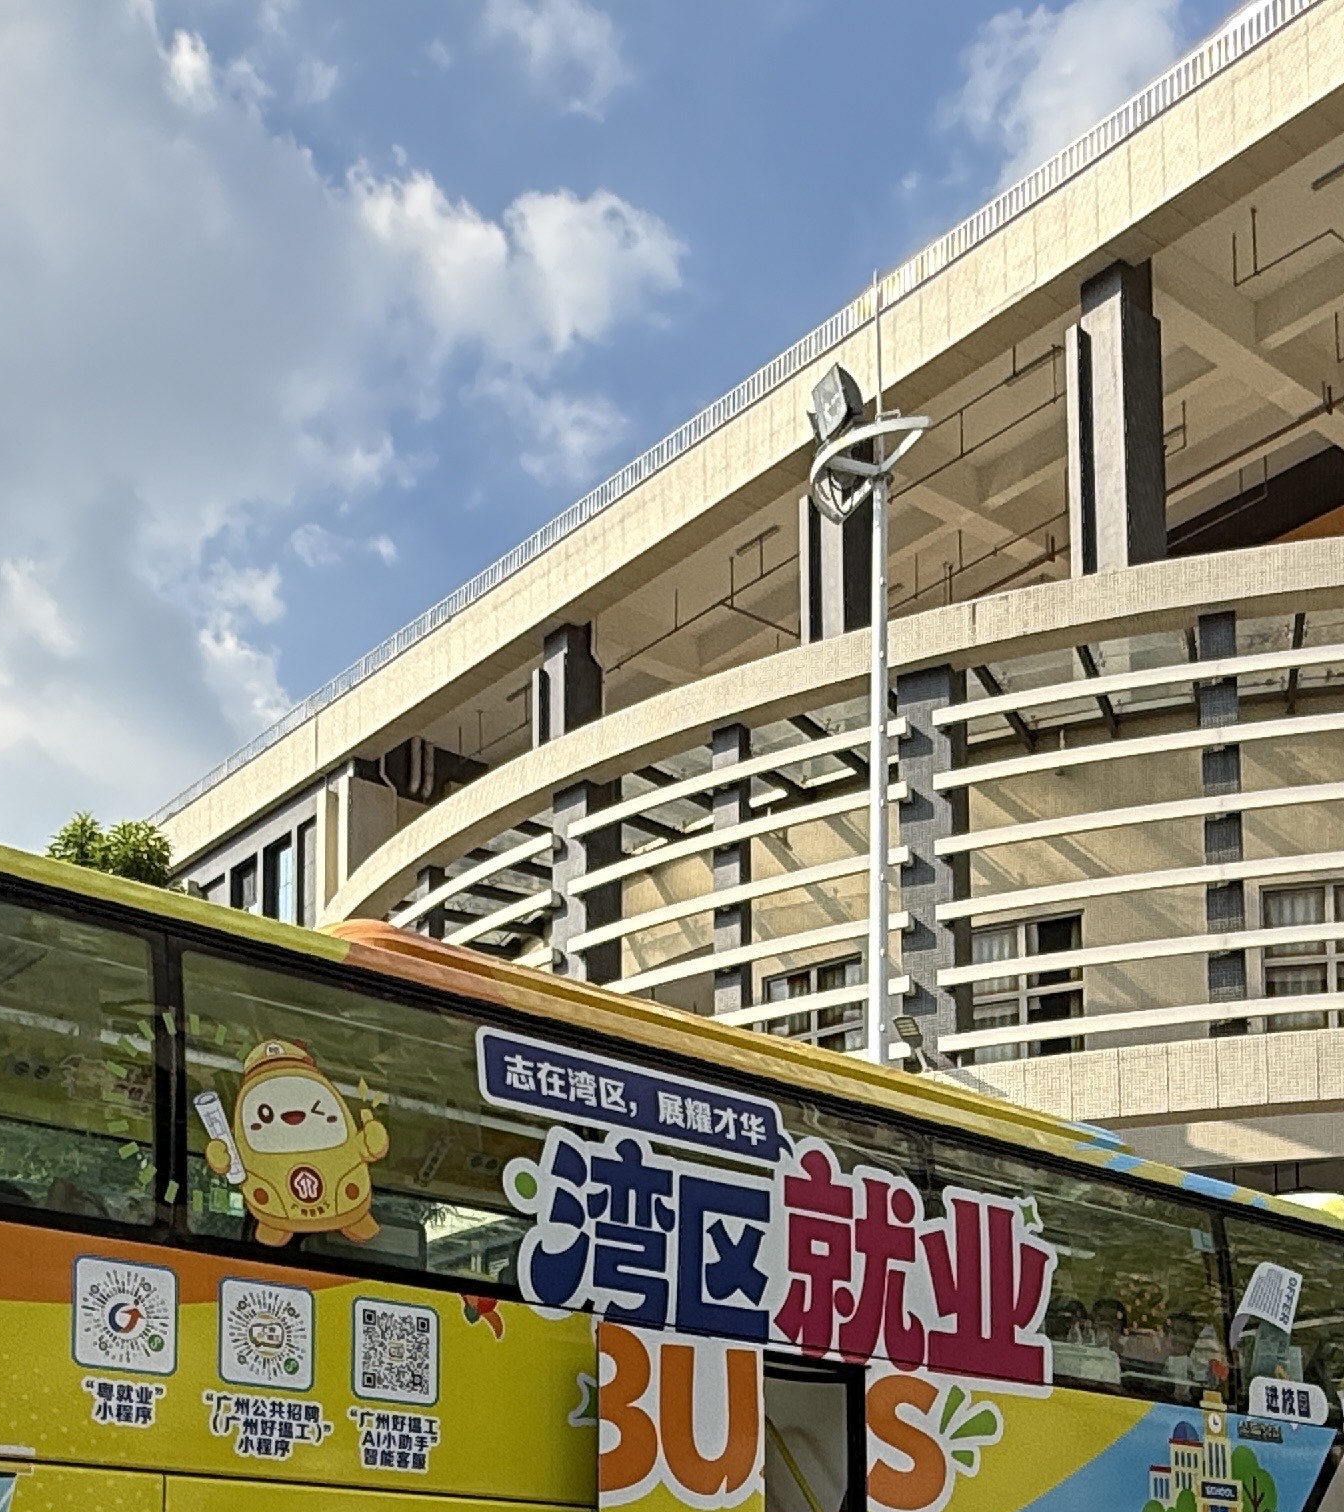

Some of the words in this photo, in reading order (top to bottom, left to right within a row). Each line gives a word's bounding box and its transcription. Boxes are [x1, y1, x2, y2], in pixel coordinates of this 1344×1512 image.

[531, 1138, 1050, 1385] 湾区就业
[1278, 1276, 1298, 1326] OFFER
[96, 1402, 152, 1424] 小程序
[1265, 1385, 1312, 1419] 进校园
[238, 1436, 290, 1457] 小程序
